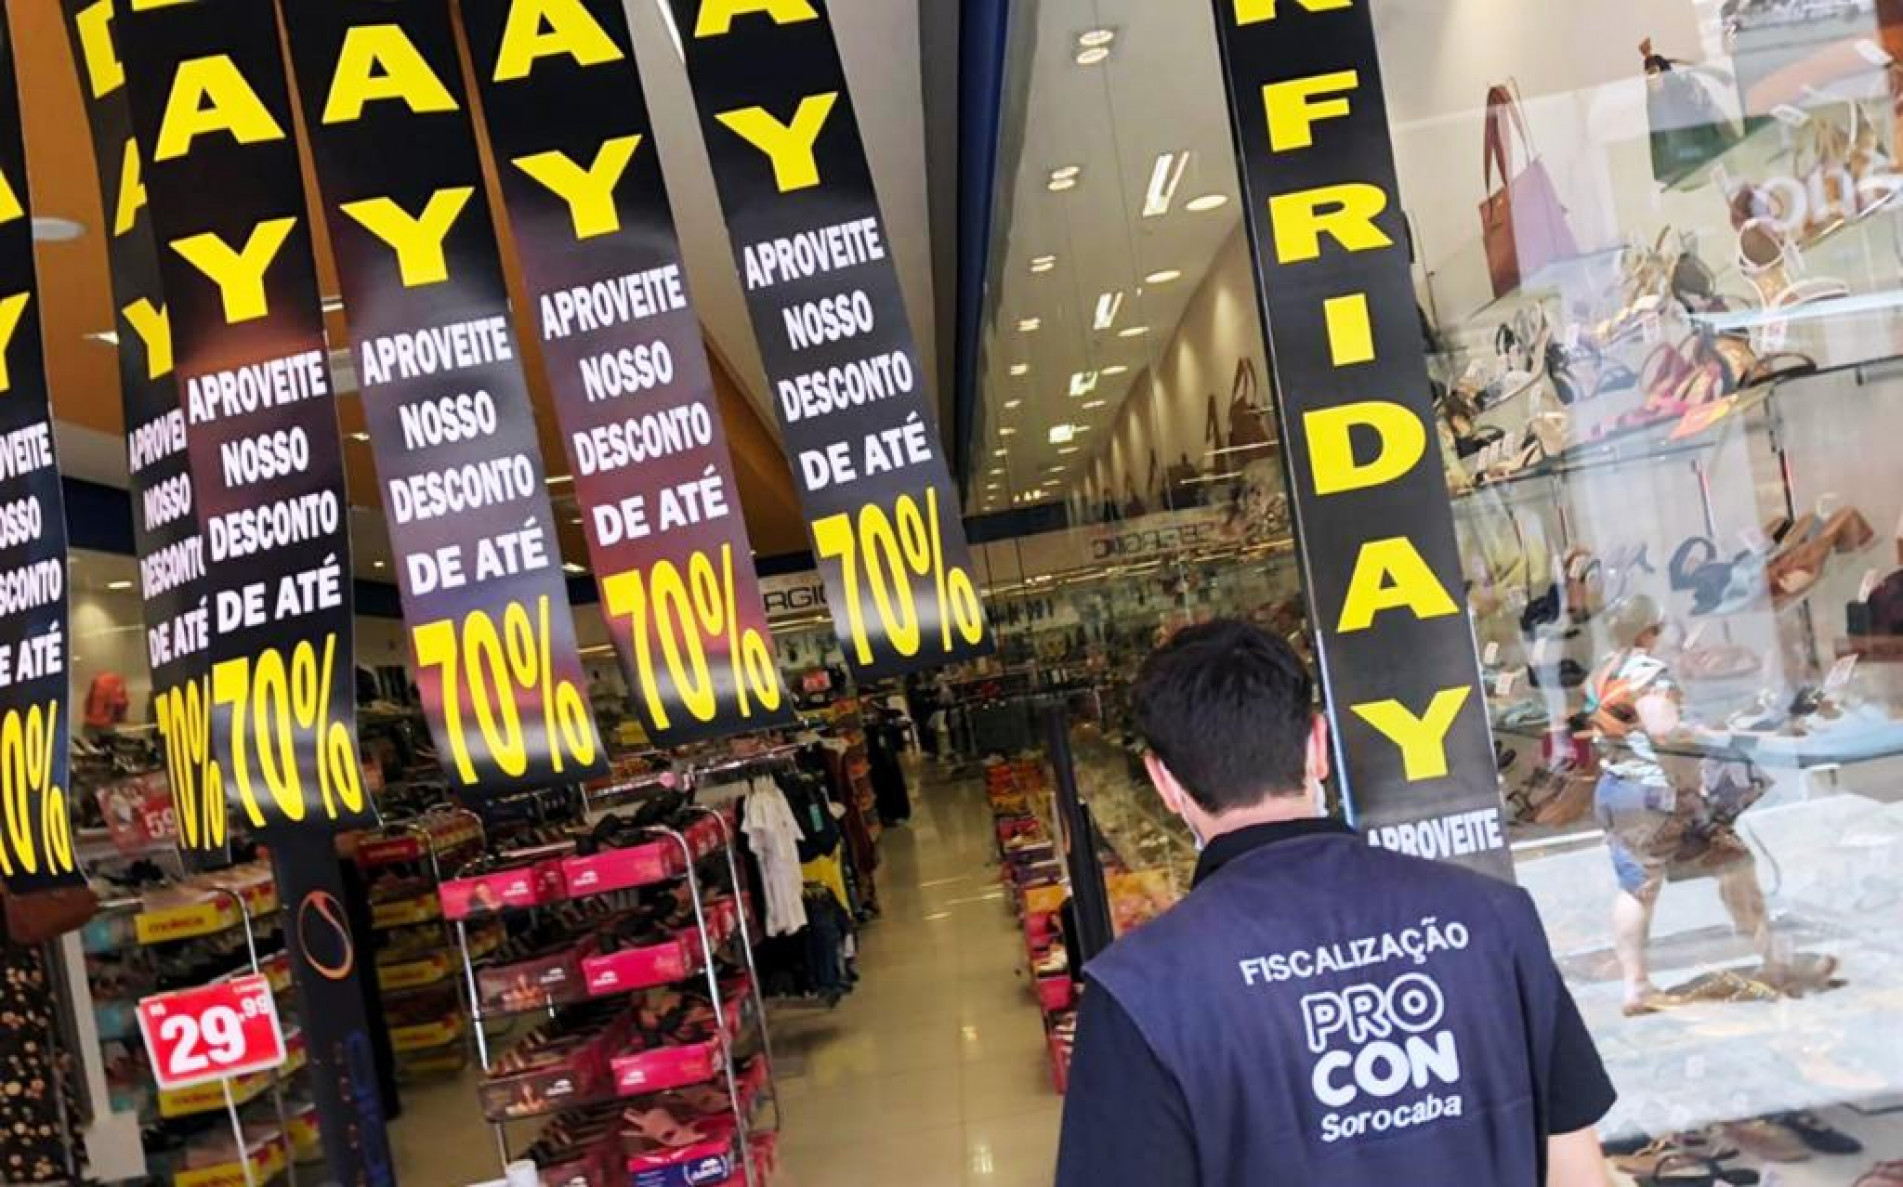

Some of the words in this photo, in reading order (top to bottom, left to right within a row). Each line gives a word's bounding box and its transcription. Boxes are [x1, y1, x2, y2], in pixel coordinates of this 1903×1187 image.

[131, 0, 297, 324] AY
[745, 216, 885, 290] APROVEITE
[541, 263, 687, 341] APROVEITE
[783, 290, 874, 350] NOSSO
[188, 350, 328, 425] APROVEITE
[361, 315, 514, 387] APROVEITE
[580, 340, 674, 402] NOSSO
[778, 350, 913, 423] DESCONTO
[221, 426, 309, 488] NOSSO
[399, 390, 497, 451] NOSSO
[573, 402, 713, 476] DESCONTO
[799, 441, 857, 491] DE
[866, 410, 932, 476] ATÉ
[1262, 70, 1472, 782] FRIDAY
[145, 472, 192, 531] NOSSO
[208, 489, 339, 562] DESCONTO
[390, 453, 536, 525] DESCONTO
[593, 495, 651, 547] DE
[660, 463, 730, 532] ATÉ
[407, 544, 467, 596] DE
[476, 514, 550, 582] ATÉ
[811, 488, 983, 666] 70%
[217, 582, 267, 633] DE
[275, 553, 342, 620] ATÉ
[17, 620, 62, 682] ATÉ
[149, 622, 172, 668] DE
[174, 595, 209, 658] ATÉ
[601, 543, 780, 731] 70%
[411, 595, 596, 785] 70%
[155, 675, 226, 852] 70%
[212, 633, 363, 828] 70%
[0, 698, 73, 876] 0%
[1239, 916, 1469, 986] FISCALIZAÇÃO
[1300, 972, 1445, 1054] PRO
[1312, 1030, 1460, 1108] CON
[1321, 1093, 1463, 1143] Sorocaba
